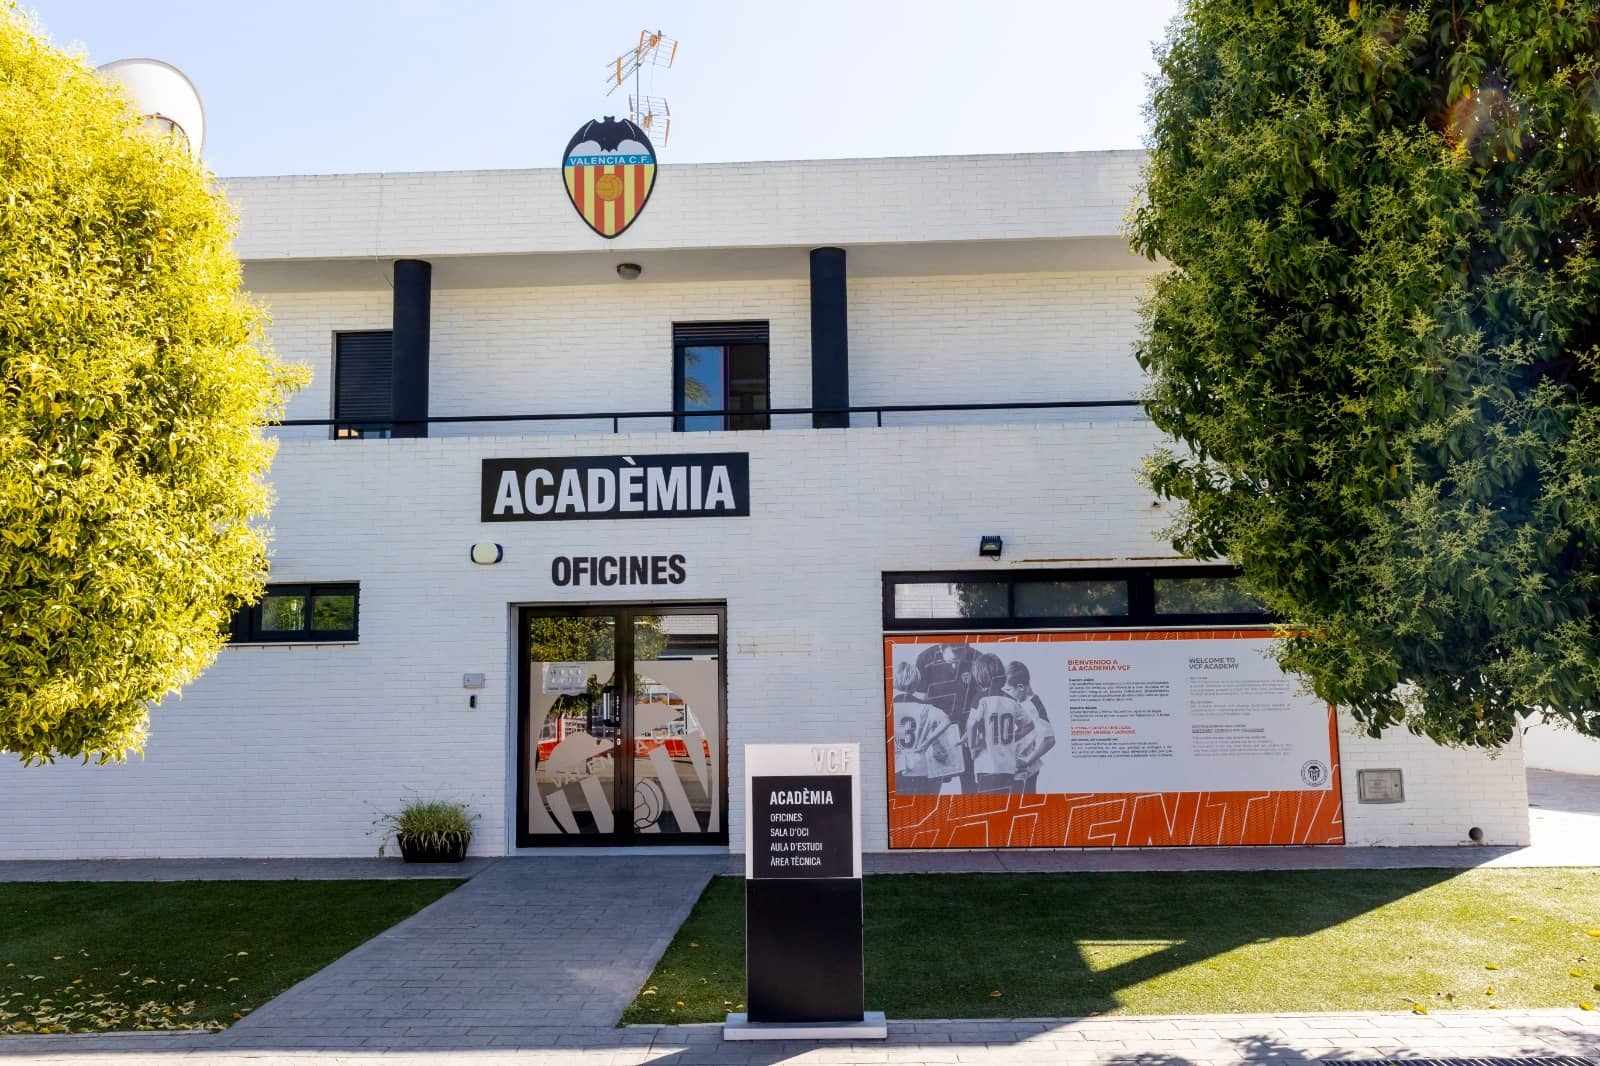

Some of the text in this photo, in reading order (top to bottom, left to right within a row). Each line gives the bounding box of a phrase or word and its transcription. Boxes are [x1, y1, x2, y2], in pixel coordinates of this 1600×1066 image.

[570, 155, 650, 165] VALENCIA C.F.
[493, 456, 736, 515] ACADÈMIA
[551, 554, 687, 587] OFICINES
[989, 713, 1015, 746] 10
[812, 746, 851, 774] VCF
[769, 787, 834, 806] ACADÈMIA
[770, 813, 803, 822] OFICINES
[770, 828, 809, 837] SALA D'OCI
[770, 842, 823, 852] AULA D'ESTUDI
[770, 855, 822, 867] ÀREA TÈCNICA
